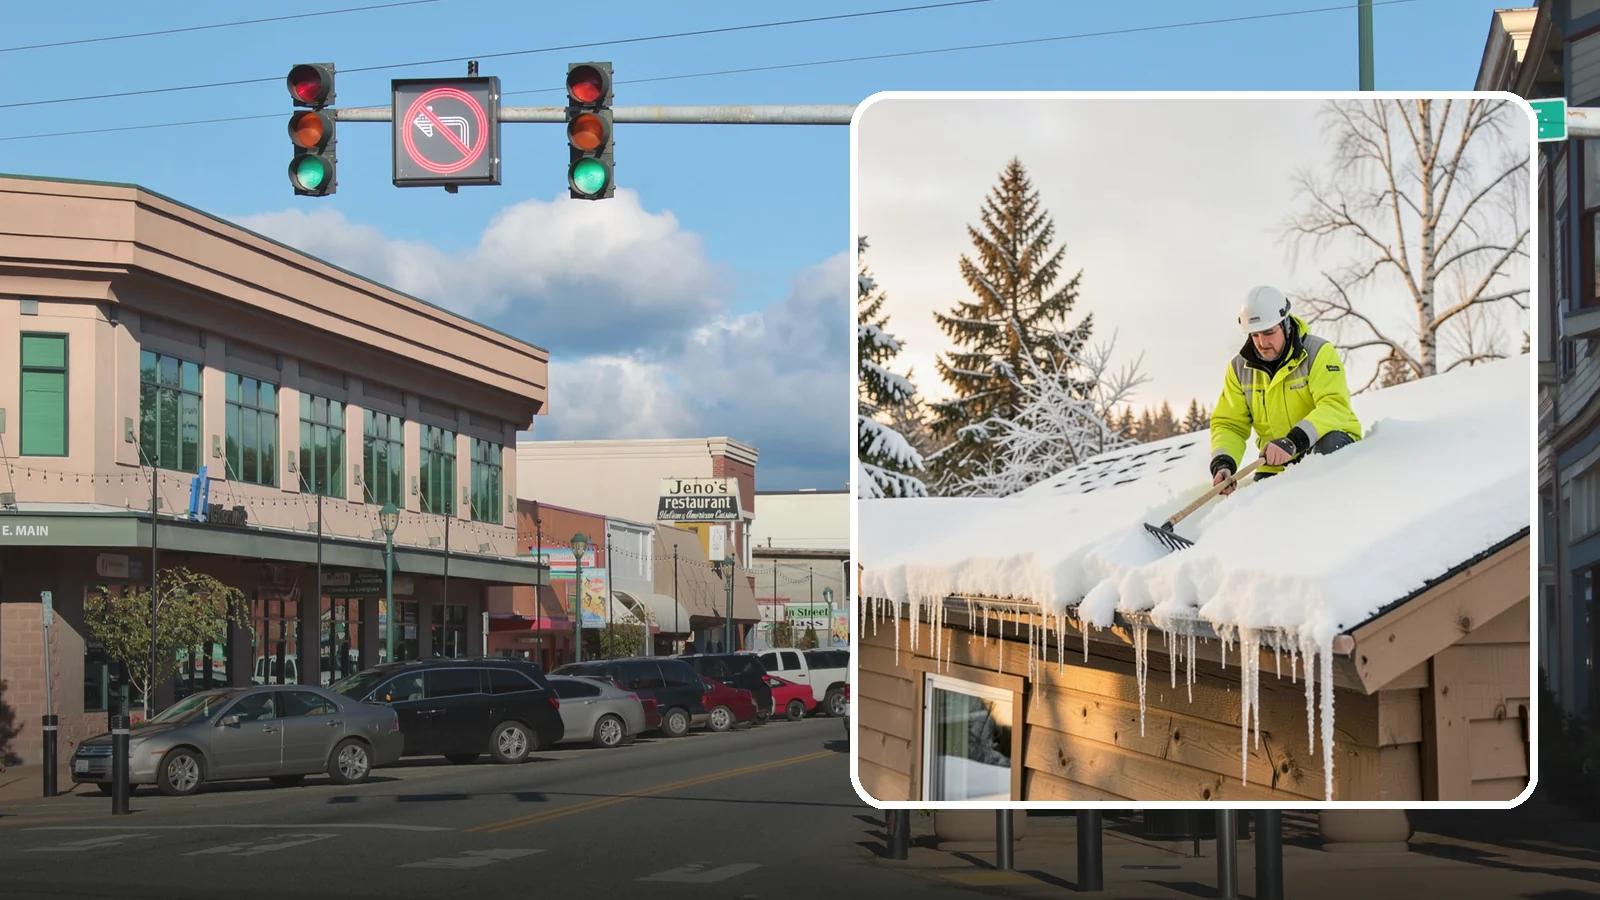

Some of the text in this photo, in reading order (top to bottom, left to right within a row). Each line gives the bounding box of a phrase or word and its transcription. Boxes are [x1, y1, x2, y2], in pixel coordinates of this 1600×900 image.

[669, 480, 728, 495] Jeno's
[665, 496, 731, 509] restaurant
[658, 510, 682, 520] Italian
[685, 509, 714, 519] American
[714, 509, 738, 519] Cuisine
[2, 525, 49, 536] E. MAIN
[785, 607, 795, 617] in
[797, 607, 828, 617] Street
[791, 619, 825, 627] lass
